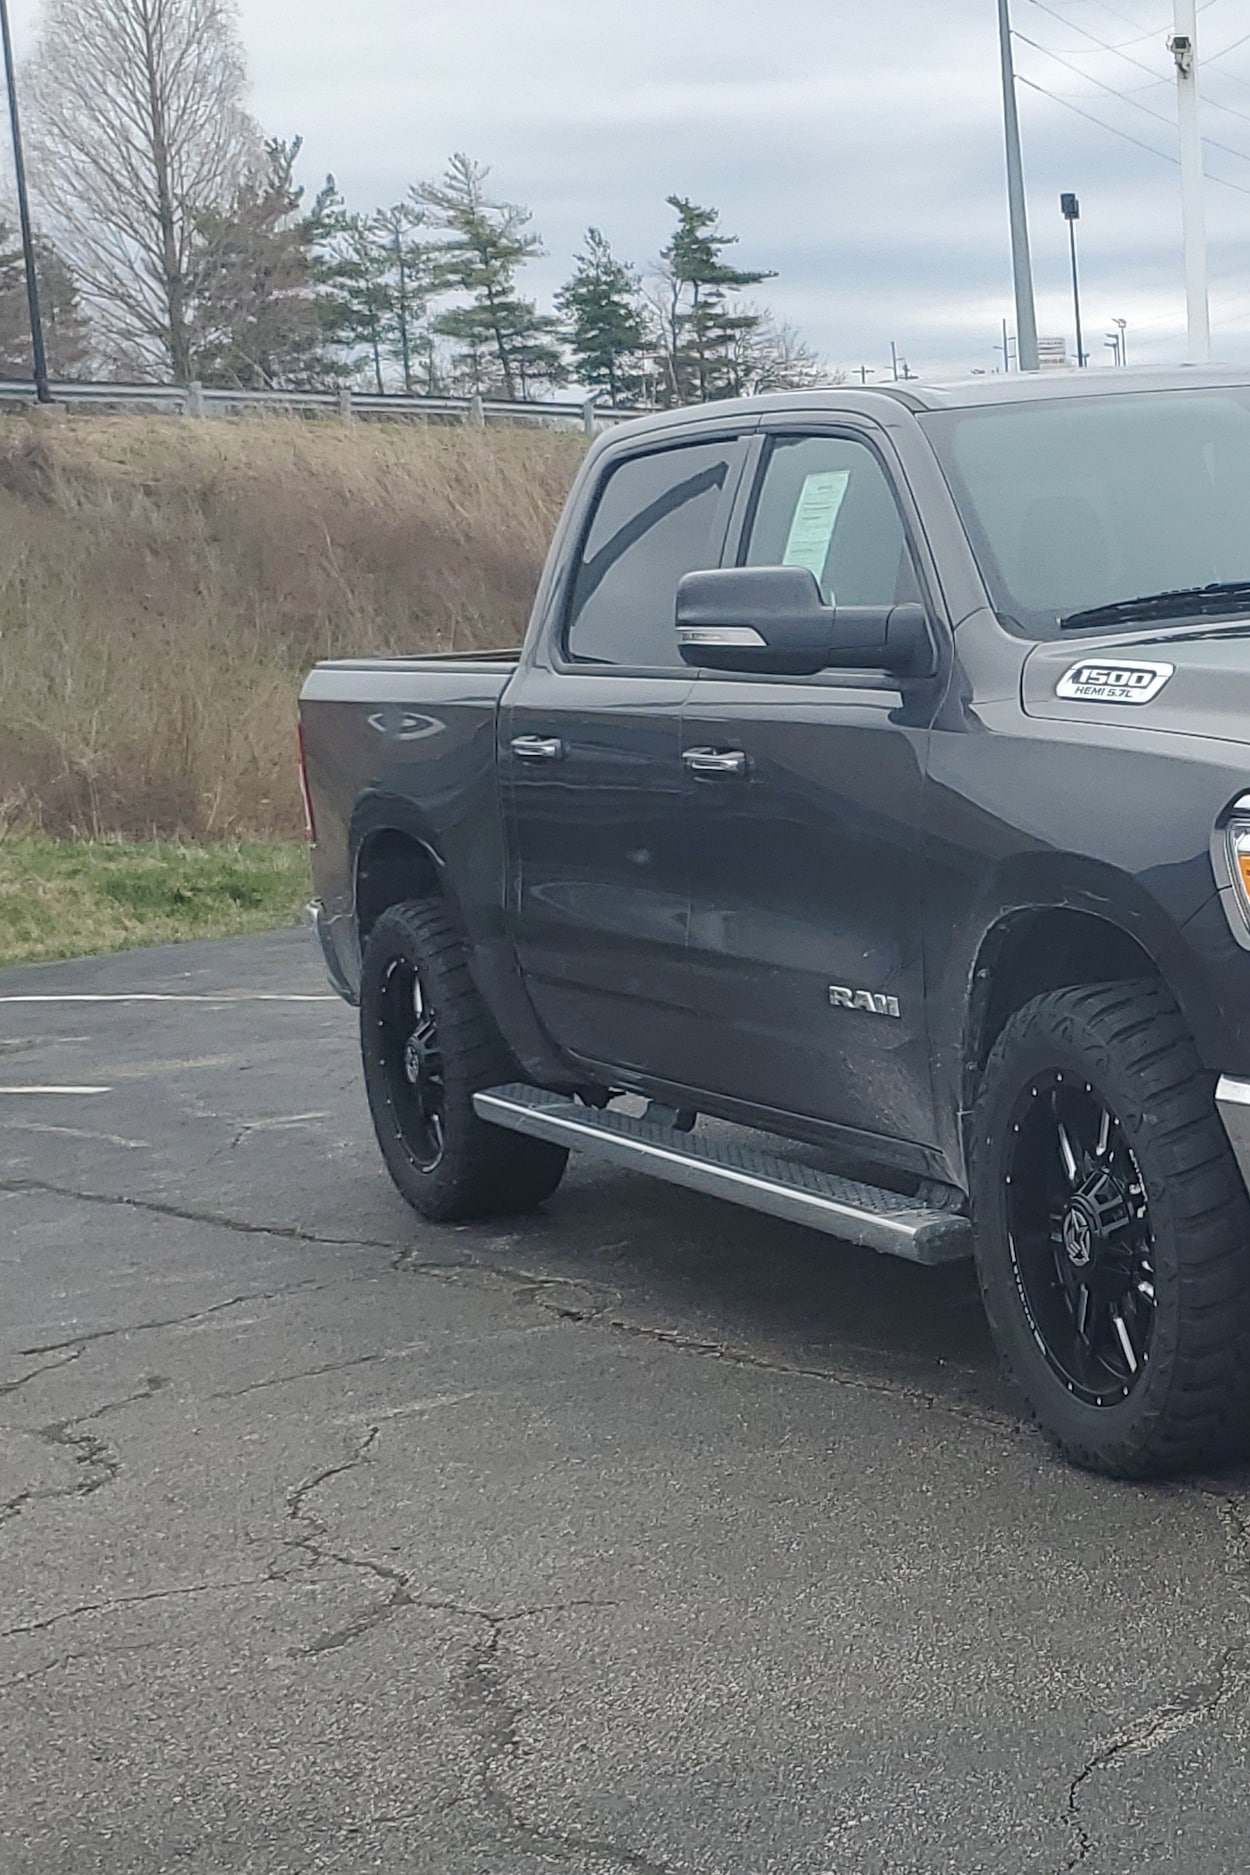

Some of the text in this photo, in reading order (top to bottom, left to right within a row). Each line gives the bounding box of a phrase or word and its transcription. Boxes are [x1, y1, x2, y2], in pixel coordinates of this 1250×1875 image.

[1078, 669, 1154, 687] 1500
[1075, 686, 1134, 698] HEMI 5.7L
[829, 985, 900, 1017] RAM
